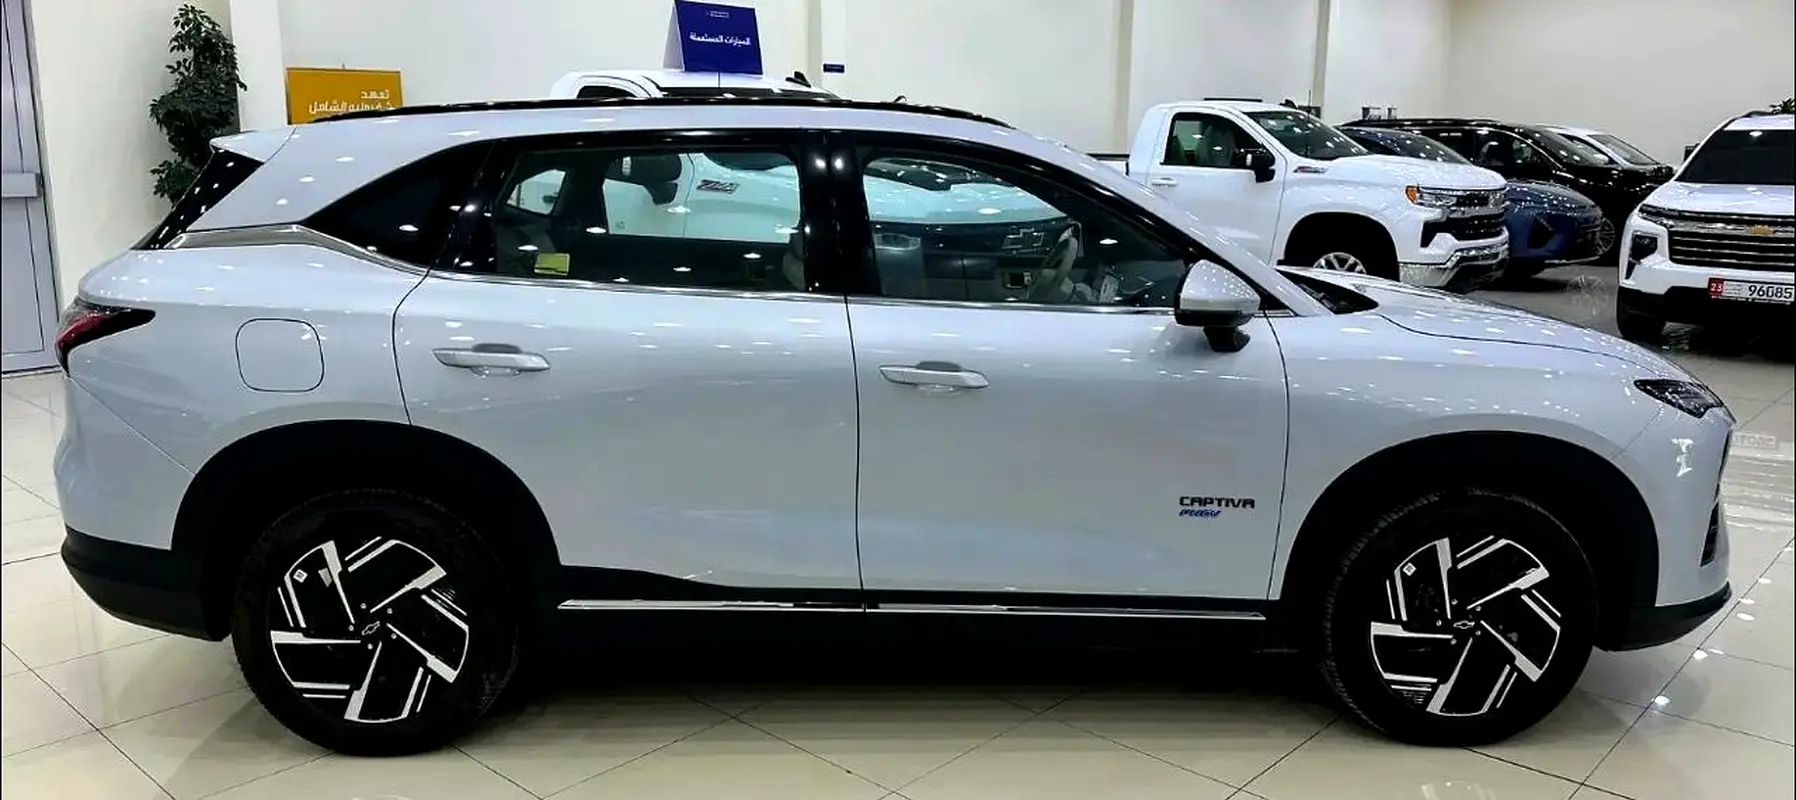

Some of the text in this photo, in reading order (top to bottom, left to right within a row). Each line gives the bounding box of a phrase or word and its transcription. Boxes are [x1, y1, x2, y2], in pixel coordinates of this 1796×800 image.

[361, 89, 390, 99] تعهد
[308, 100, 348, 115] الشامل
[1710, 283, 1723, 292] 23
[1748, 284, 1794, 299] 96085
[1179, 496, 1256, 509] CAPTIVA
